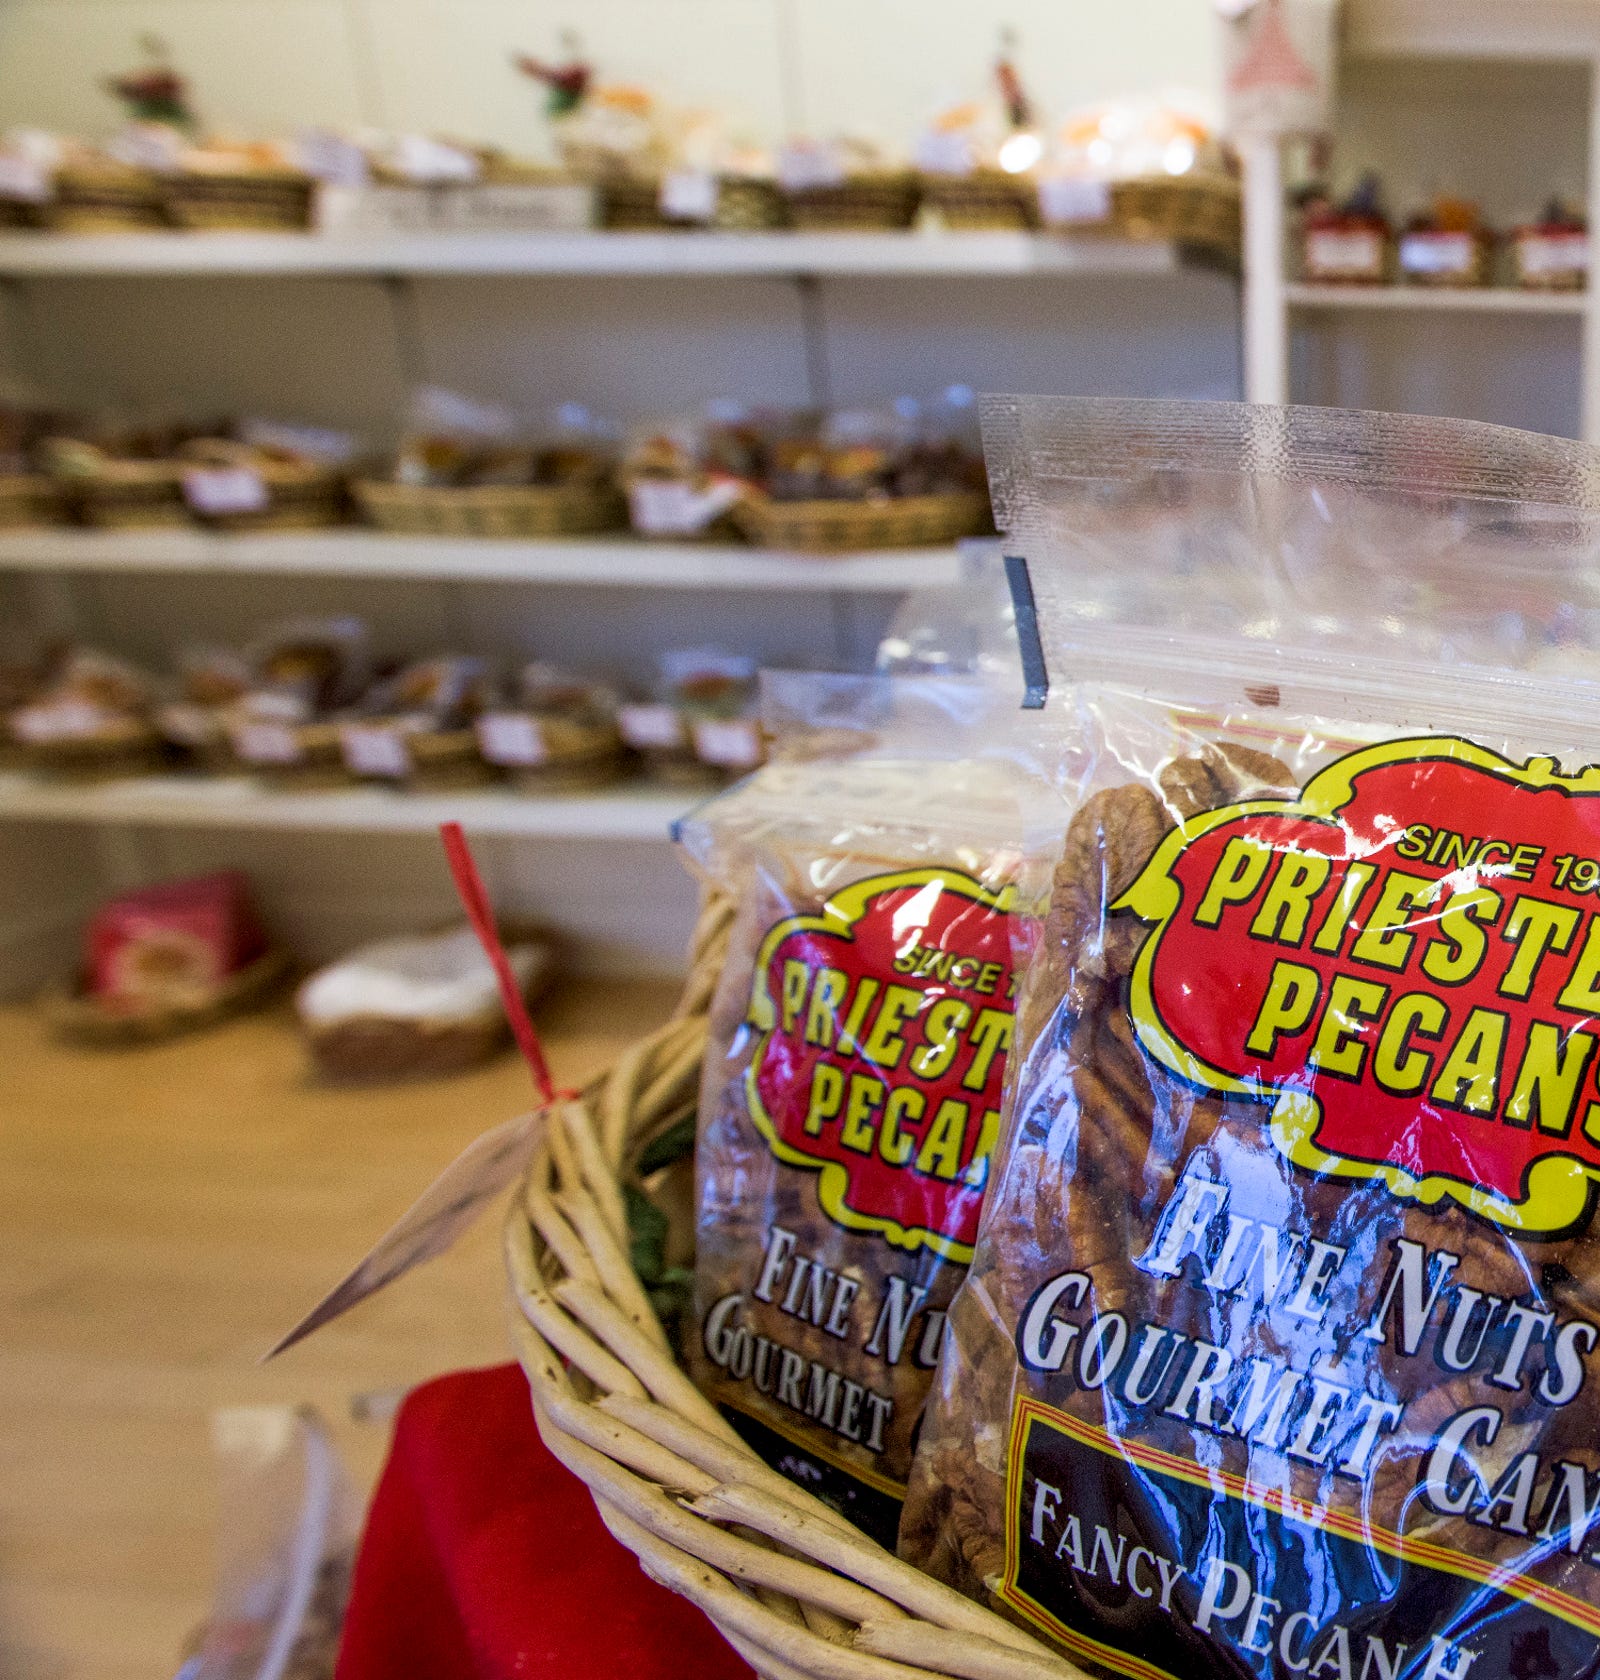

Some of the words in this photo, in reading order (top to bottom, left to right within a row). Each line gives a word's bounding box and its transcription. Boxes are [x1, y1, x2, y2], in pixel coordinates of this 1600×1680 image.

[1396, 823, 1545, 882] SINCE
[781, 957, 1016, 1092] PRIEST
[893, 944, 1004, 995] SINCE
[805, 1062, 1001, 1190] PECA
[754, 1224, 862, 1342] FINE
[1136, 1170, 1350, 1324] FINE
[1362, 1237, 1600, 1408] NUTS
[704, 1294, 894, 1455] GOURMET
[1016, 1271, 1405, 1482] GOURMET
[1029, 1477, 1188, 1614] FANCY
[1191, 1556, 1408, 1680] PECAN
